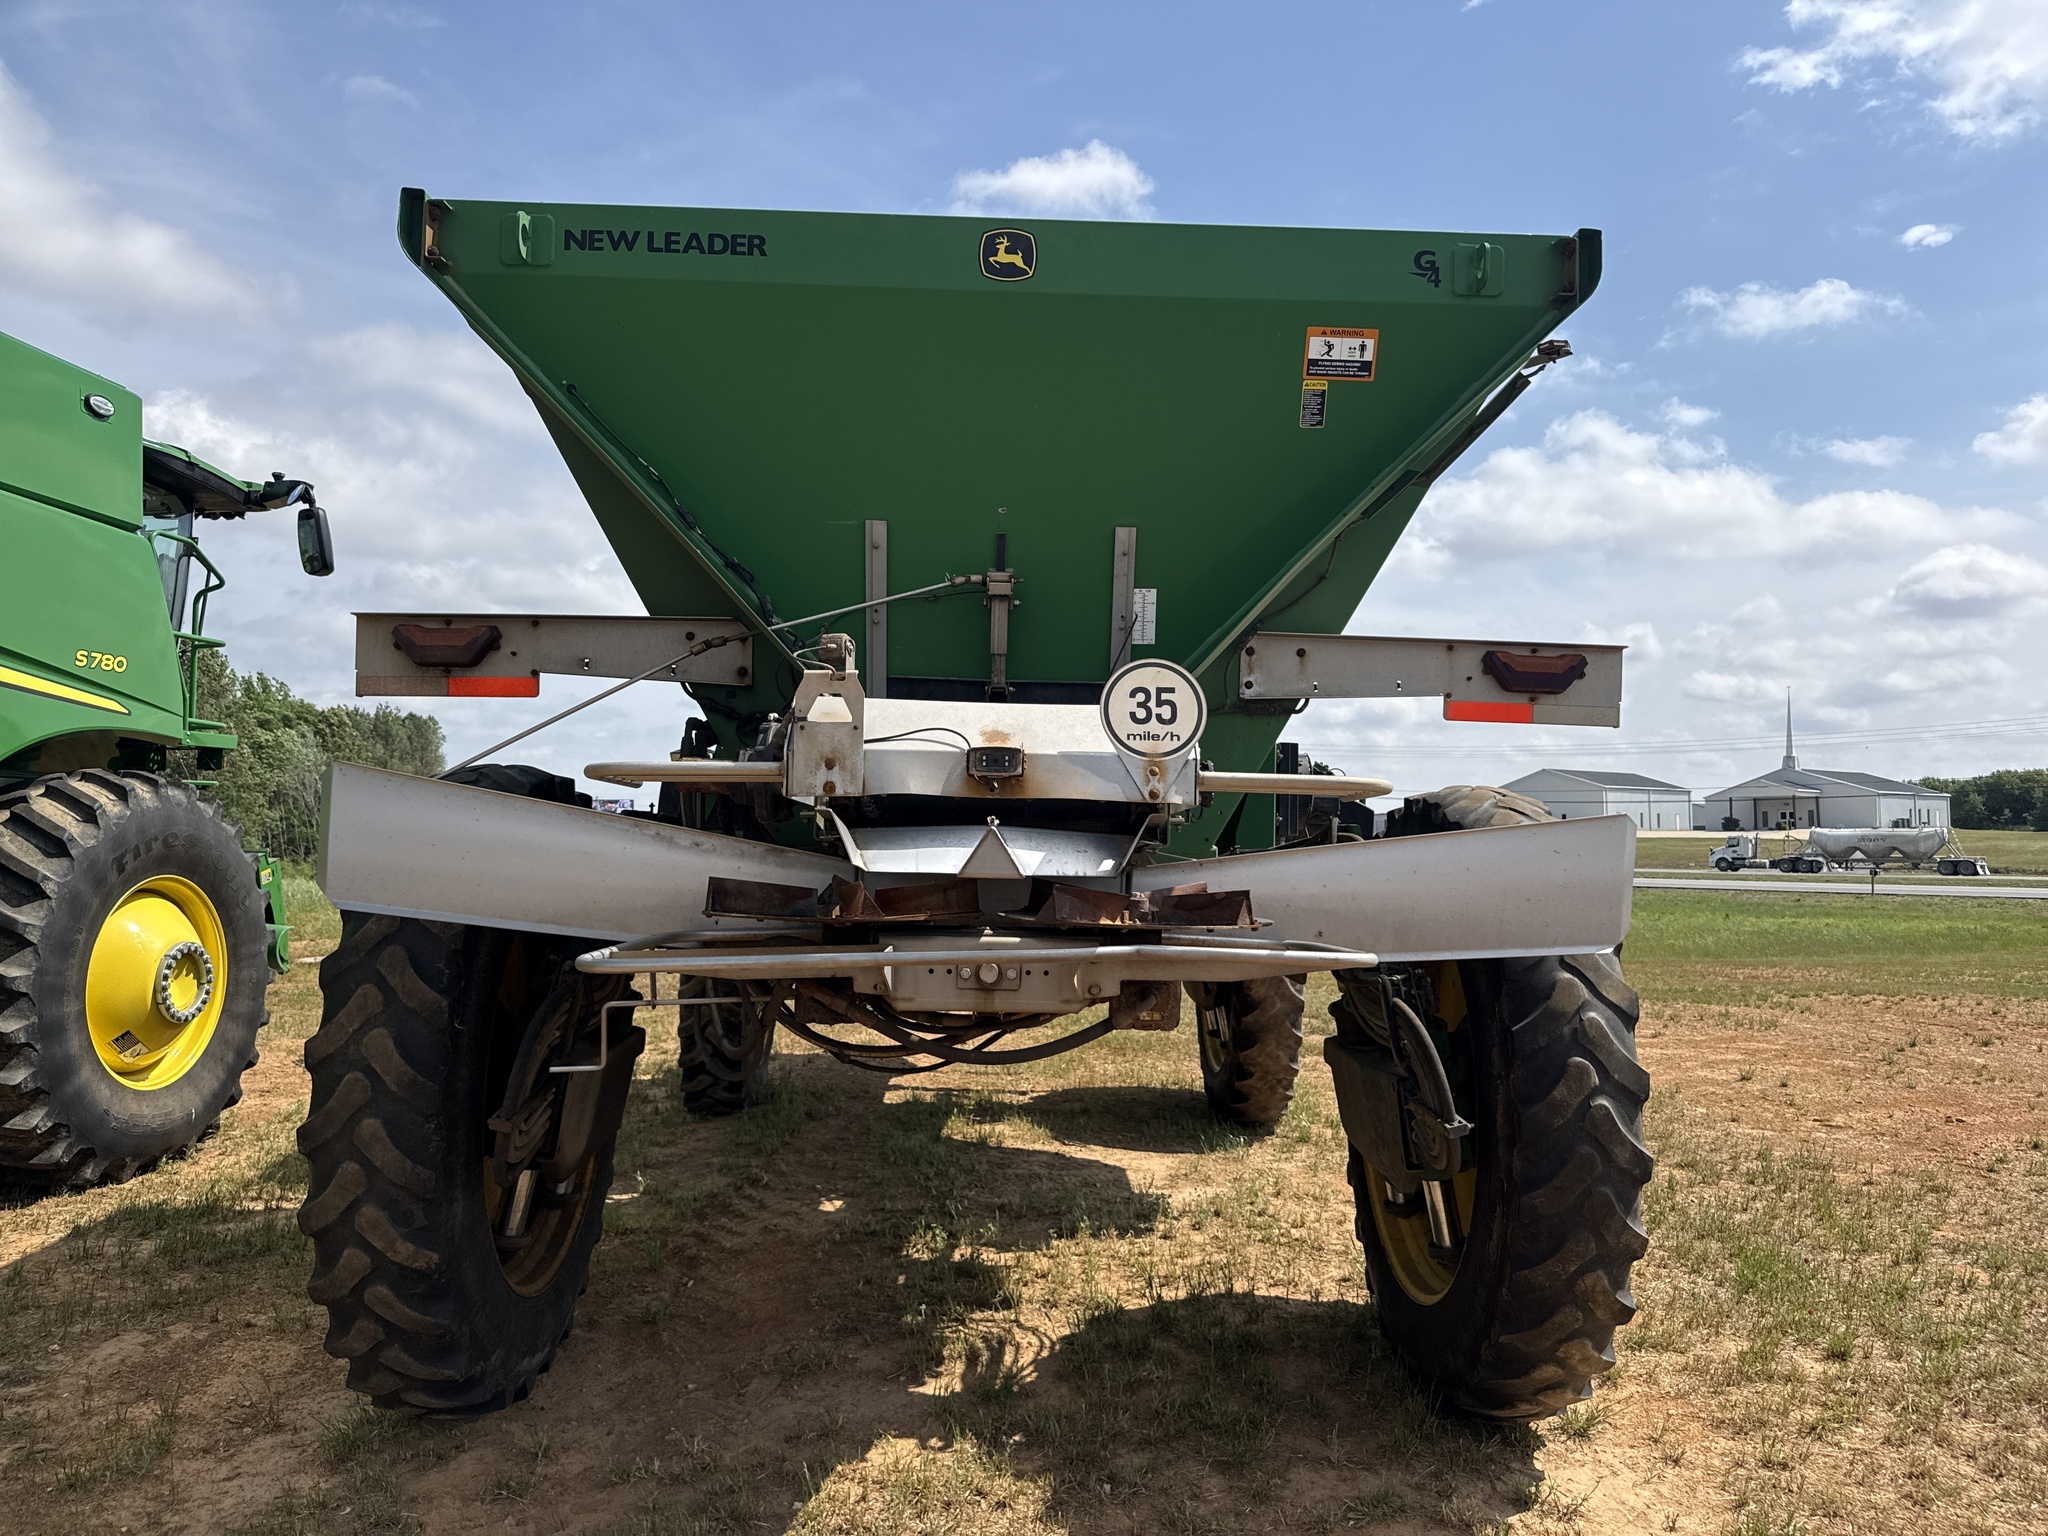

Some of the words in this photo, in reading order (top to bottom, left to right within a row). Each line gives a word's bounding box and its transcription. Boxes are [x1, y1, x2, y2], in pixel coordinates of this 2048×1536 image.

[564, 229, 642, 251] NEW
[647, 231, 768, 257] LEADER
[1128, 686, 1178, 726] 35
[1126, 731, 1181, 742] mile/h
